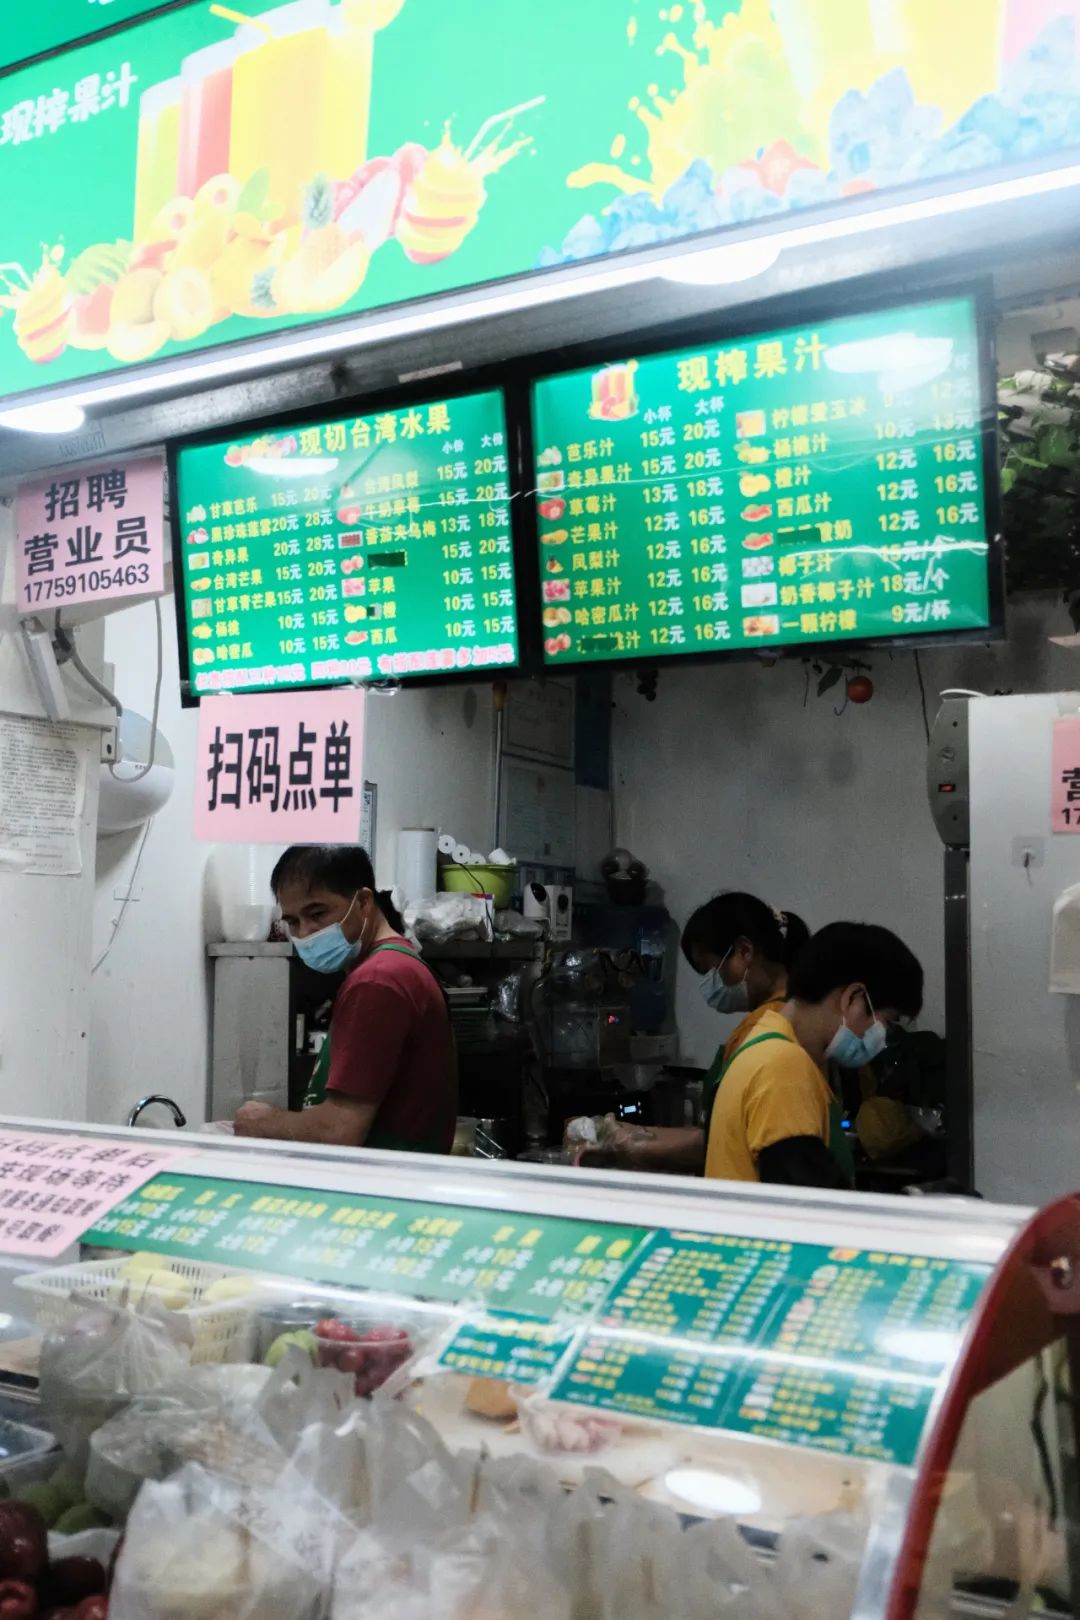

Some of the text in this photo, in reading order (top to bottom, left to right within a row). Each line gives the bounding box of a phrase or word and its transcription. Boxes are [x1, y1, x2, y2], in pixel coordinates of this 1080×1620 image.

[676, 333, 828, 392] 现榨果汁
[643, 395, 725, 424] 小杯 大杯
[300, 403, 451, 455] 现切台湾水果
[566, 418, 721, 462] 芭乐汁 15元 20元
[875, 417, 916, 440] 10元
[437, 461, 468, 481] 15元
[474, 454, 507, 475] 20元
[642, 455, 676, 475] 15元
[684, 447, 722, 469] 20元
[876, 448, 918, 471] 12元
[933, 439, 977, 463] 16元
[44, 469, 128, 523] 招聘
[271, 490, 298, 507] 15元
[303, 484, 332, 502] 20元
[438, 487, 469, 507] 15元
[476, 482, 508, 502] 20元
[569, 476, 724, 517] 草莓汁 13元 18元
[776, 470, 978, 518] 西瓜汁 12元 16元
[272, 514, 299, 532] 20元
[305, 509, 333, 527] 28元
[441, 515, 471, 533] 13元
[479, 509, 509, 528] 18元
[570, 505, 726, 544] 芒果汁 12元 16元
[776, 502, 979, 546] 酸奶 12元 16元
[23, 515, 152, 577] 营业员
[273, 539, 301, 557] 20元
[306, 534, 334, 552] 28元
[442, 535, 511, 559] 15元 20元
[572, 534, 727, 571] 凤梨汁 12元 16元
[214, 559, 336, 590] 台湾芒果 15元 20元
[368, 562, 512, 595] 苹果 10元 15元
[574, 562, 729, 598] 苹果汁 12元 16元
[778, 552, 833, 577] 椰子汁
[24, 563, 150, 603] 17759105463
[277, 588, 304, 606] 15元
[309, 584, 338, 602] 20元
[779, 567, 950, 606] 奶香椰子汁 18元/个
[278, 613, 305, 630] 10元
[312, 609, 339, 626] 15元
[368, 588, 513, 620] 橙 10元 15元
[574, 591, 730, 626] 哈密瓜汁 12元 16元
[782, 599, 951, 634] 一颗柠檬 9元/杯
[279, 637, 306, 655] 10元
[313, 633, 340, 651] 15元
[370, 615, 515, 645] 西瓜 10元 15元
[576, 620, 731, 654] 桃汁 12元 16元
[207, 720, 353, 813] 扫码点单
